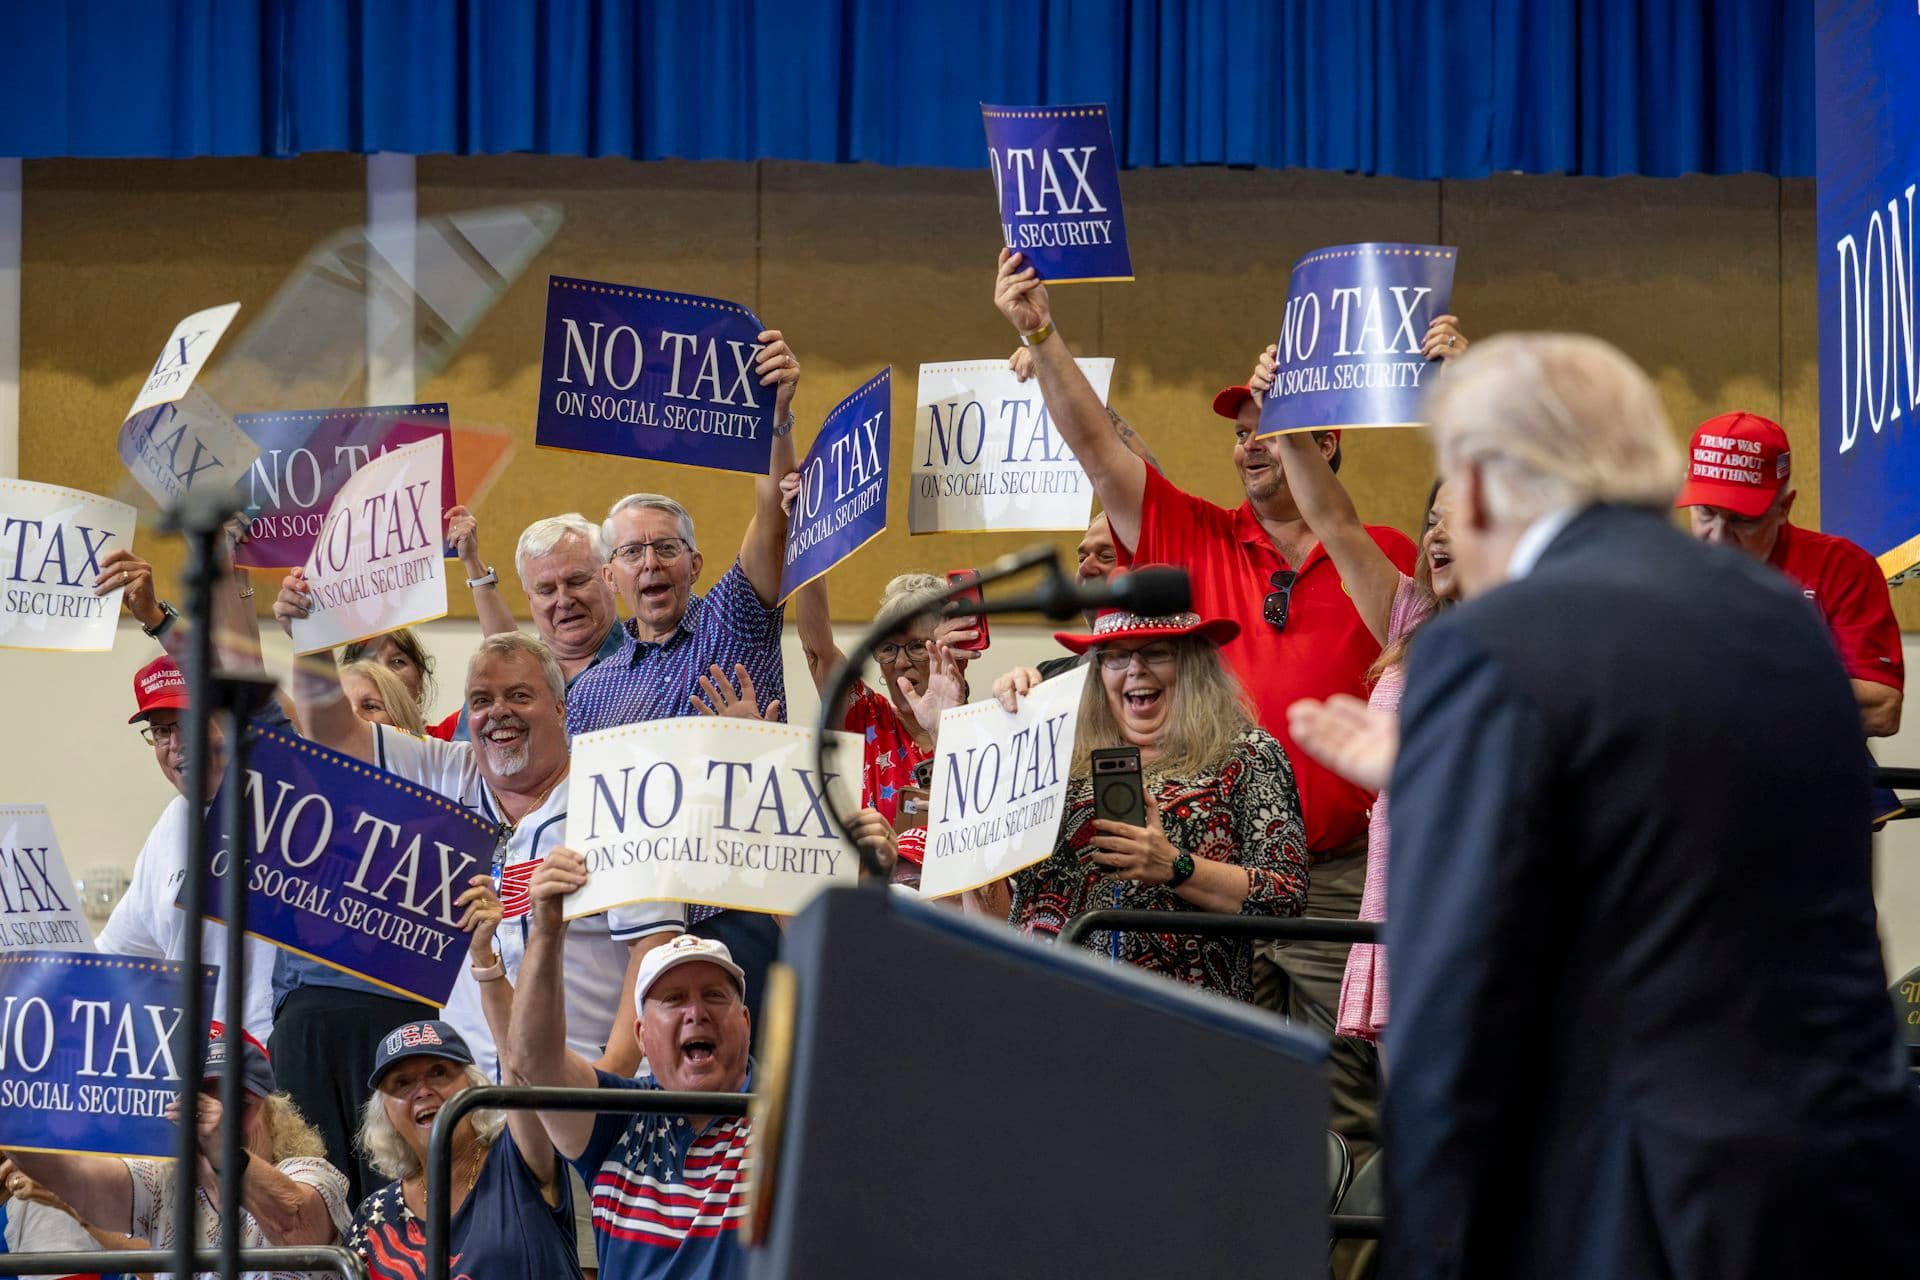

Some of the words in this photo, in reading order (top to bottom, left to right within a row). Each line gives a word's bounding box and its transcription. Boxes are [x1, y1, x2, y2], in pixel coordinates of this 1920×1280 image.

[1007, 146, 1107, 216] TAX
[1018, 220, 1112, 248] SECURITY
[1275, 292, 1320, 366] NO
[1331, 287, 1432, 356] TAX
[1837, 184, 1920, 454] DON
[557, 318, 643, 391] NO
[660, 330, 766, 409] TAX
[1284, 366, 1330, 396] SOCIAL
[1332, 362, 1426, 390] SECURITY
[556, 390, 586, 417] ON
[589, 394, 659, 427] SOCIAL
[663, 404, 762, 440] SECURITY
[922, 401, 986, 467] NO
[1700, 434, 1736, 450] TRUMP
[1737, 439, 1762, 454] WAS
[247, 448, 322, 510] NO
[790, 456, 824, 539] NO
[830, 410, 883, 503] TAX
[921, 475, 942, 498] ON
[944, 472, 997, 497] SOCIAL
[1000, 470, 1083, 495] SECURITY
[1693, 448, 1724, 464] RIGHT
[1723, 454, 1764, 469] ABOUT
[4, 517, 116, 588] TAX
[250, 515, 277, 539] ON
[363, 480, 431, 563] TAX
[786, 535, 800, 566] ON
[799, 513, 834, 555] SOCIAL
[835, 478, 883, 531] SECURITY
[5, 589, 110, 618] SECURITY
[324, 574, 369, 608] SOCIAL
[371, 556, 435, 595] SECURITY
[584, 761, 683, 841] NO
[706, 760, 841, 840] TAX
[939, 743, 1000, 824] NO
[1007, 712, 1068, 804] TAX
[584, 844, 616, 874] ON
[622, 836, 708, 867] SOCIAL
[714, 839, 842, 876] SECURITY
[936, 830, 958, 858] ON
[958, 816, 1001, 853] SOCIAL
[1003, 793, 1058, 839] SECURITY
[343, 811, 477, 927] TAX
[11, 920, 84, 946] SECURITY
[248, 864, 331, 917] SOCIAL
[333, 897, 455, 962] SECURITY
[71, 999, 184, 1080] TAX
[386, 1024, 442, 1056] USA
[1, 1079, 73, 1111] SOCIAL
